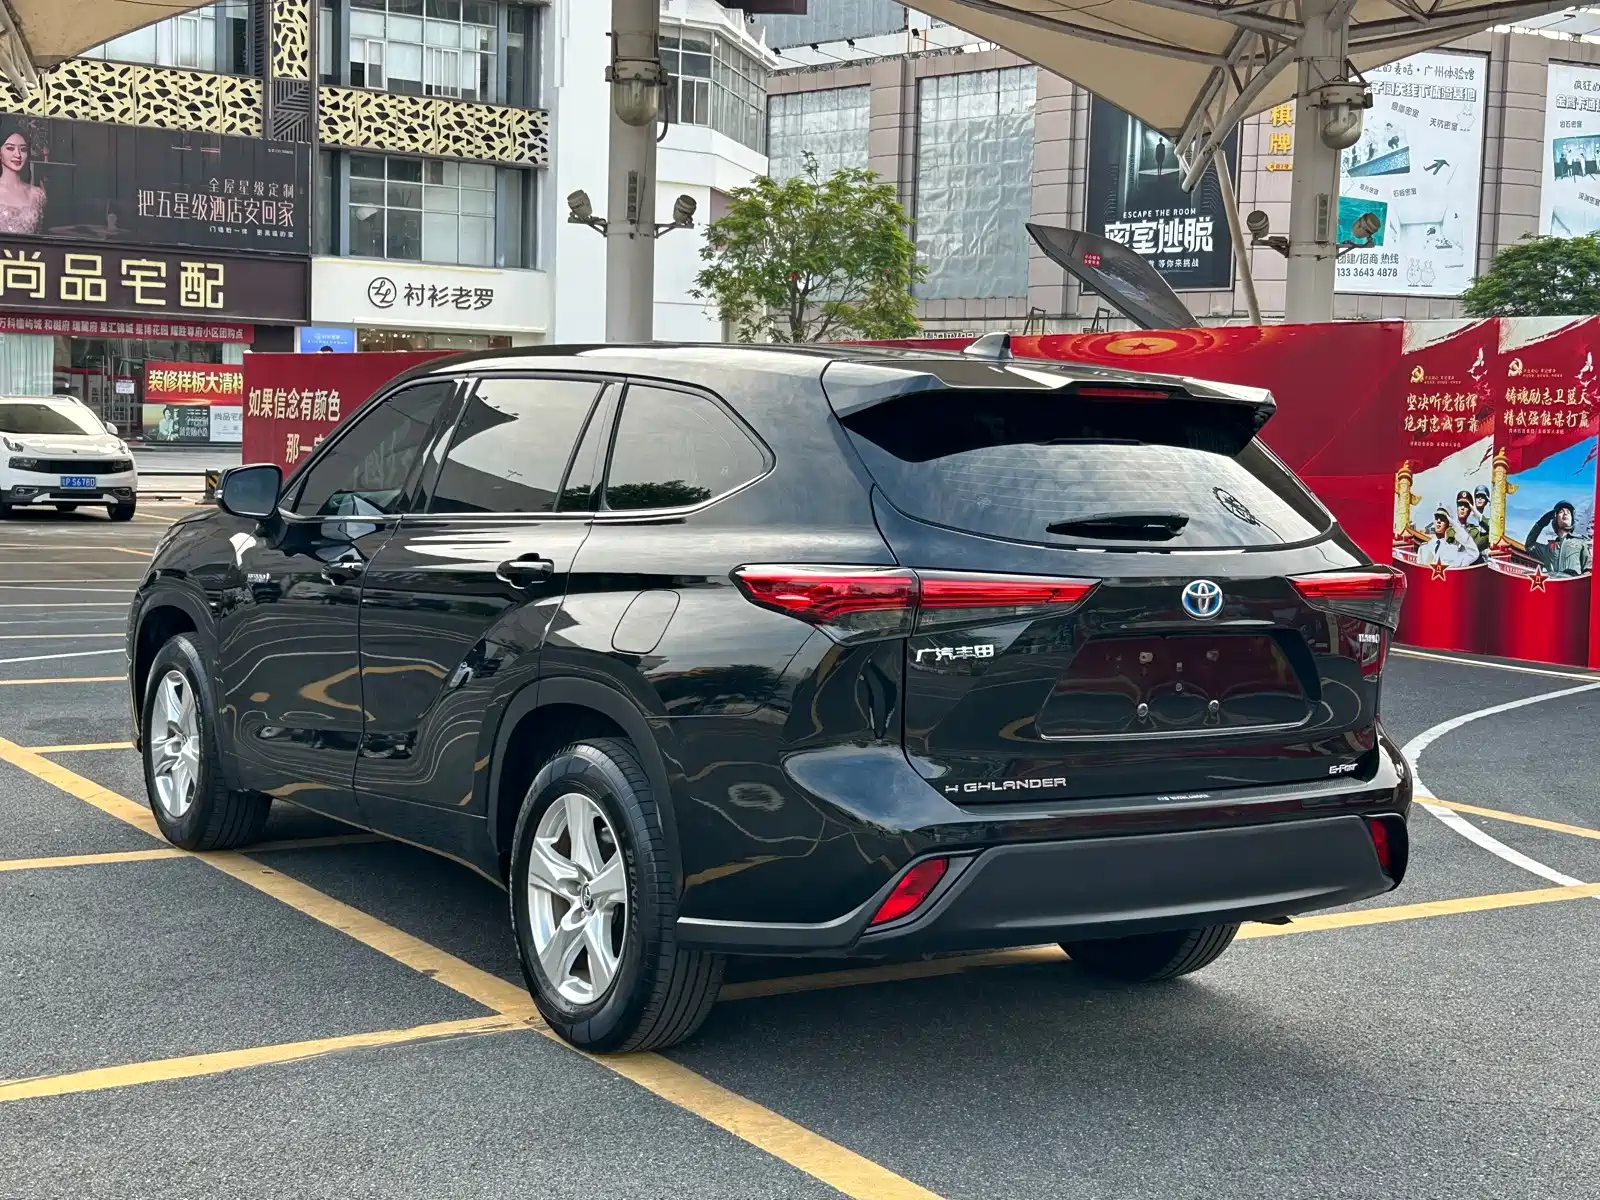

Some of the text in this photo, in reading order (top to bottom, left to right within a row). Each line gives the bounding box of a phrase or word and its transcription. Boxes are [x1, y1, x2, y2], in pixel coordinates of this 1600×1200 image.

[1365, 80, 1477, 102] 子闯关线下体验基地
[209, 177, 294, 199] 全屋星级定制
[137, 188, 294, 227] 把五星级酒店安回家
[1123, 207, 1196, 219] ESCAPE THE ROOM
[1104, 216, 1215, 255] 密室逃脱
[1158, 257, 1199, 268] 等你来挑战
[1380, 252, 1400, 265] 热线
[0, 249, 224, 309] 尚品宅配
[1336, 267, 1398, 277] 133 3643 4878
[403, 282, 494, 311] 衬衫老罗
[247, 386, 341, 422] 如果信念有颜色
[1406, 392, 1479, 412] 坚决听党指挥
[1504, 386, 1592, 406] 铸魂励志卫蓝天
[1404, 414, 1480, 434] 绝对忠诚可靠
[1503, 409, 1590, 428] 精武强能谋打赢
[915, 644, 995, 662] 广汽丰田
[944, 777, 1067, 794] HGHLANDER
